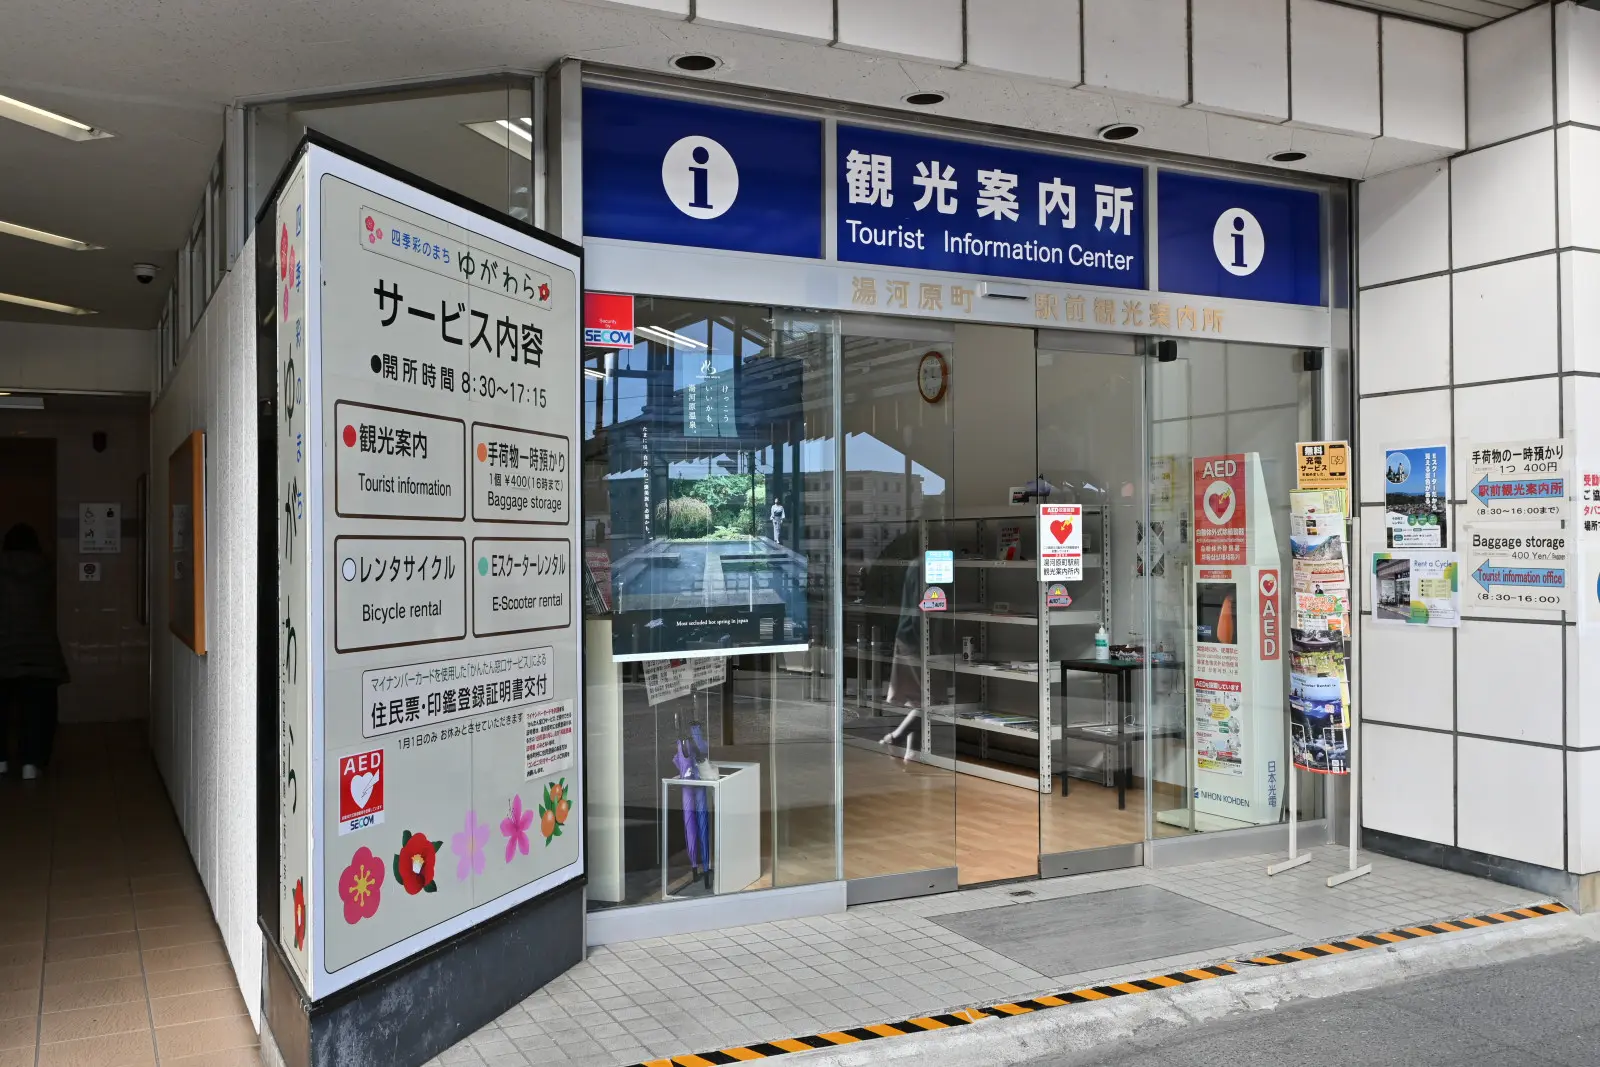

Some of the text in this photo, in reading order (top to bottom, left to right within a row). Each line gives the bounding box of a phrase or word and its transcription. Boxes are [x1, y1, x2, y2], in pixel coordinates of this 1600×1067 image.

[846, 149, 1134, 235] 観光案内所
[846, 219, 1134, 271] Tourist Information Center
[391, 229, 535, 300] 四季彩のまち ゆがわら
[851, 276, 1224, 332] 湯河原町 駅前観光案内所
[373, 279, 545, 368] サービス内容
[585, 330, 631, 344] SECOM
[722, 385, 730, 423] けっこう
[359, 423, 428, 459] 観光案内
[487, 441, 565, 473] 手荷物一時預かり
[1306, 457, 1322, 465] 充電
[1471, 445, 1564, 464] 手荷物の一時預かり
[1202, 459, 1237, 479] AED
[1523, 461, 1557, 472] 400円
[358, 472, 452, 497] Tourist information
[1479, 482, 1563, 497] 駅前観光案内所
[1584, 474, 1600, 486] 受動
[487, 491, 562, 513] Baggage storage
[1472, 534, 1565, 550] Baggage storage
[491, 554, 566, 577] Eスクーターレンタル
[1435, 560, 1452, 568] Cycle
[1511, 551, 1530, 560] 400
[360, 555, 456, 583] レンタサイクル
[1477, 567, 1563, 584] Tourist information office
[362, 600, 442, 624] Bicycle rental
[492, 593, 563, 611] E-Scooter rental
[1262, 600, 1276, 656] AED
[398, 731, 438, 750] 1月1日のみ
[343, 752, 381, 776] AED
[1267, 760, 1277, 807] 日本光電
[1201, 790, 1250, 807] NIHON KOHDEN
[350, 814, 374, 831] SECOM
